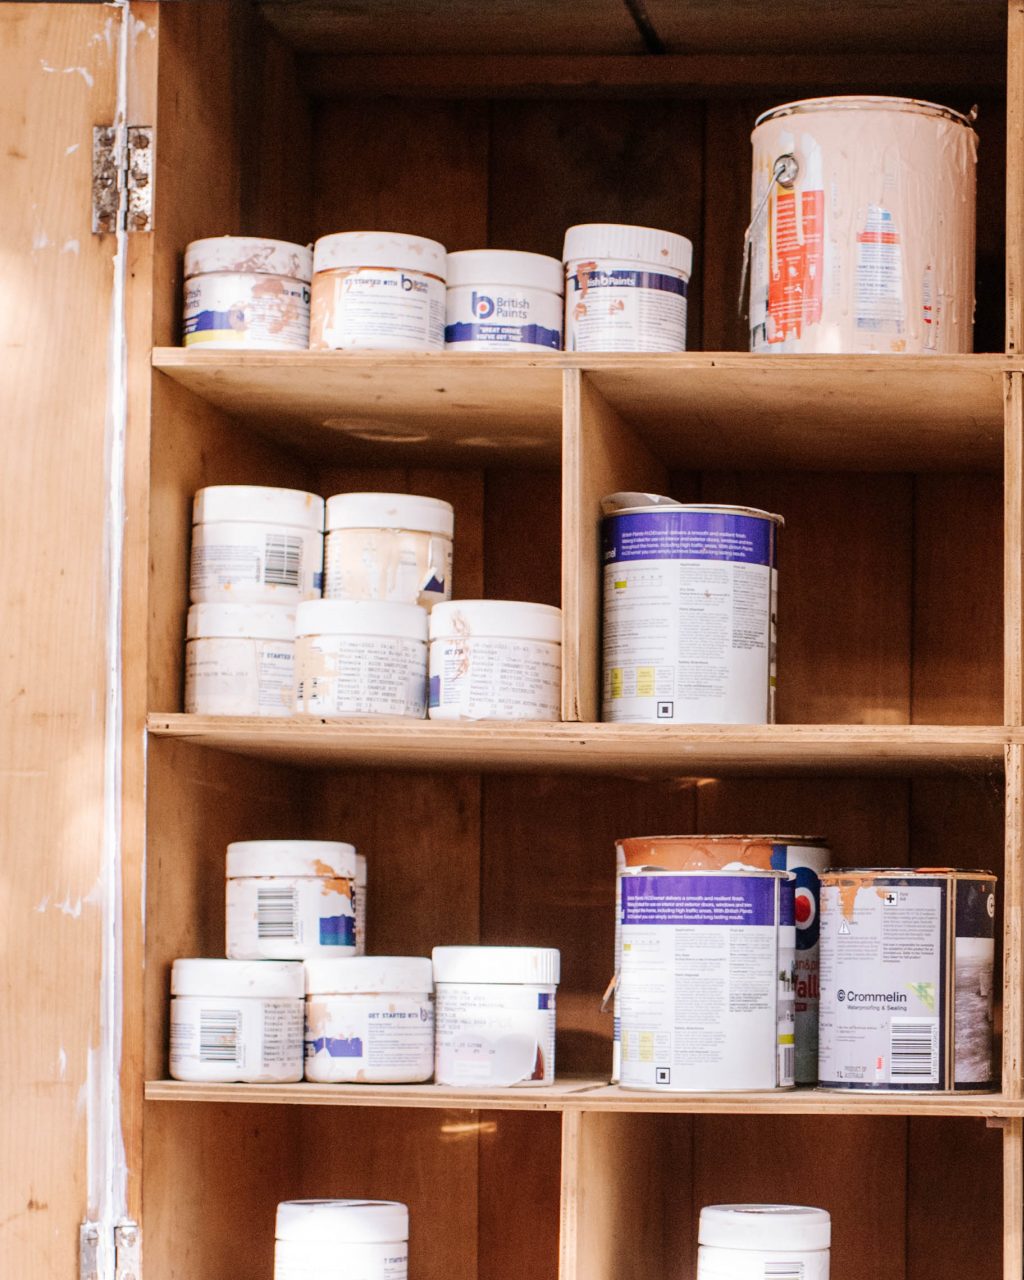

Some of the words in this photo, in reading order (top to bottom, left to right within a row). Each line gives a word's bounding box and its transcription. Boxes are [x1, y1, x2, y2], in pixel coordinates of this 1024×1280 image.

[497, 297, 530, 309] British
[496, 308, 527, 319] Paints
[847, 991, 907, 1002] Crommelin
